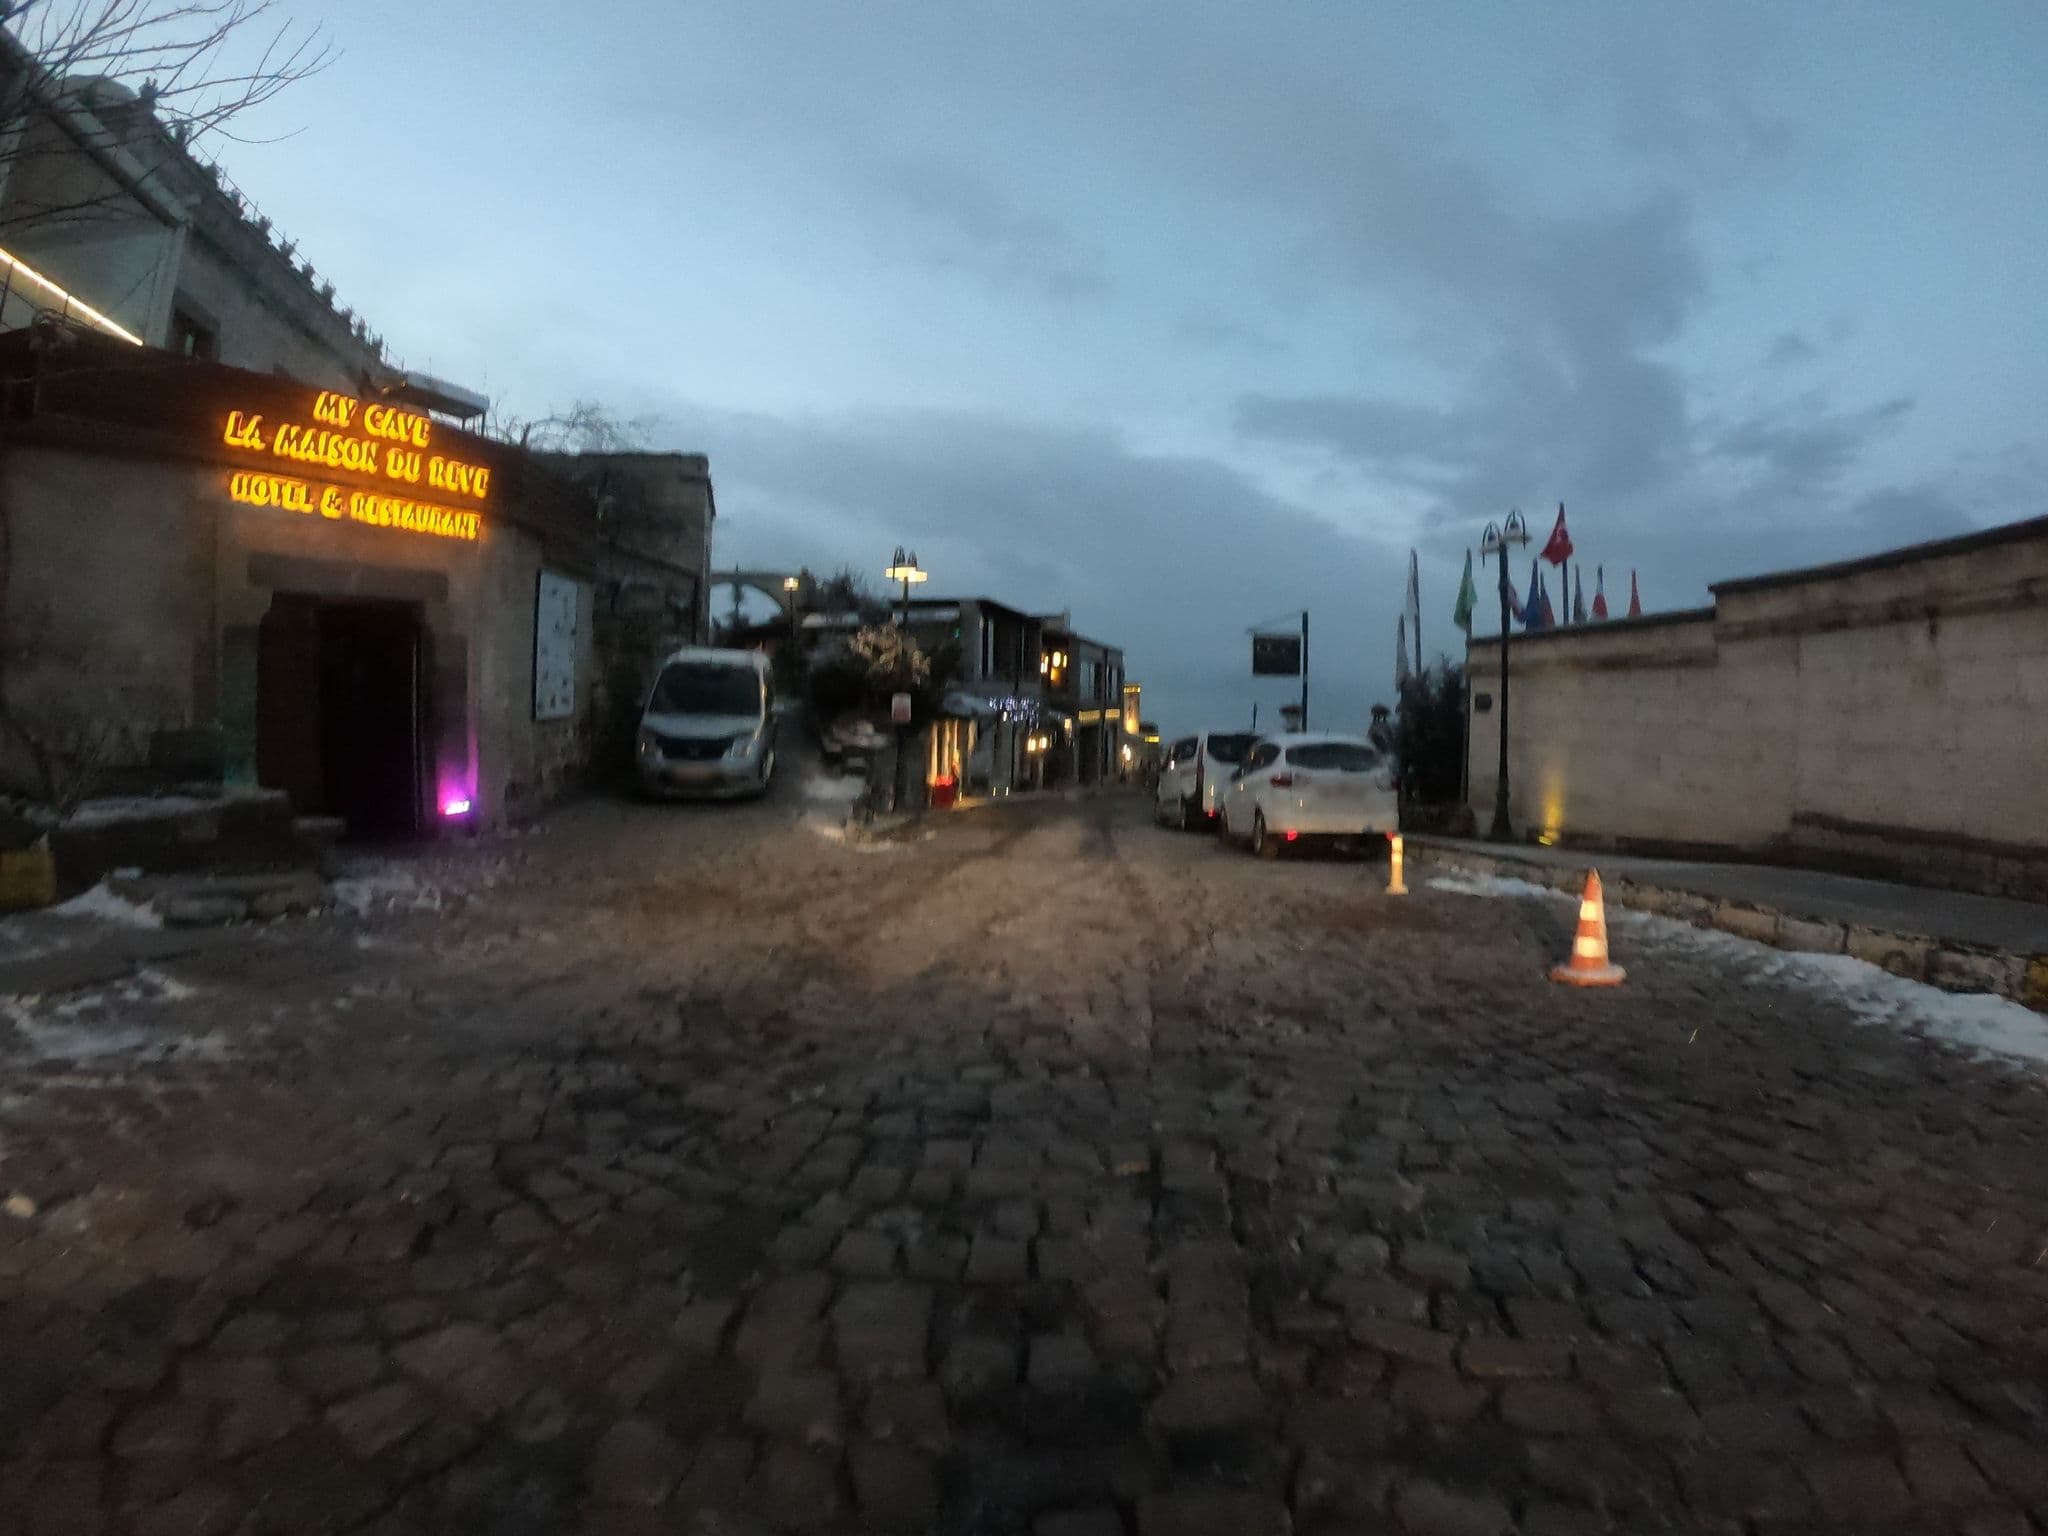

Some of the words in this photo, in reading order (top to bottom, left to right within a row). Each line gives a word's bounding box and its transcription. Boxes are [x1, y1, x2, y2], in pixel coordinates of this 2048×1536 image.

[224, 411, 265, 450] LA
[273, 424, 379, 473] MAISON
[386, 447, 423, 483] DU
[314, 391, 358, 427] MY
[364, 404, 432, 448] CAVE
[231, 473, 313, 513] HOTEL
[321, 485, 343, 518] &
[351, 492, 481, 540] RESTAURANT
